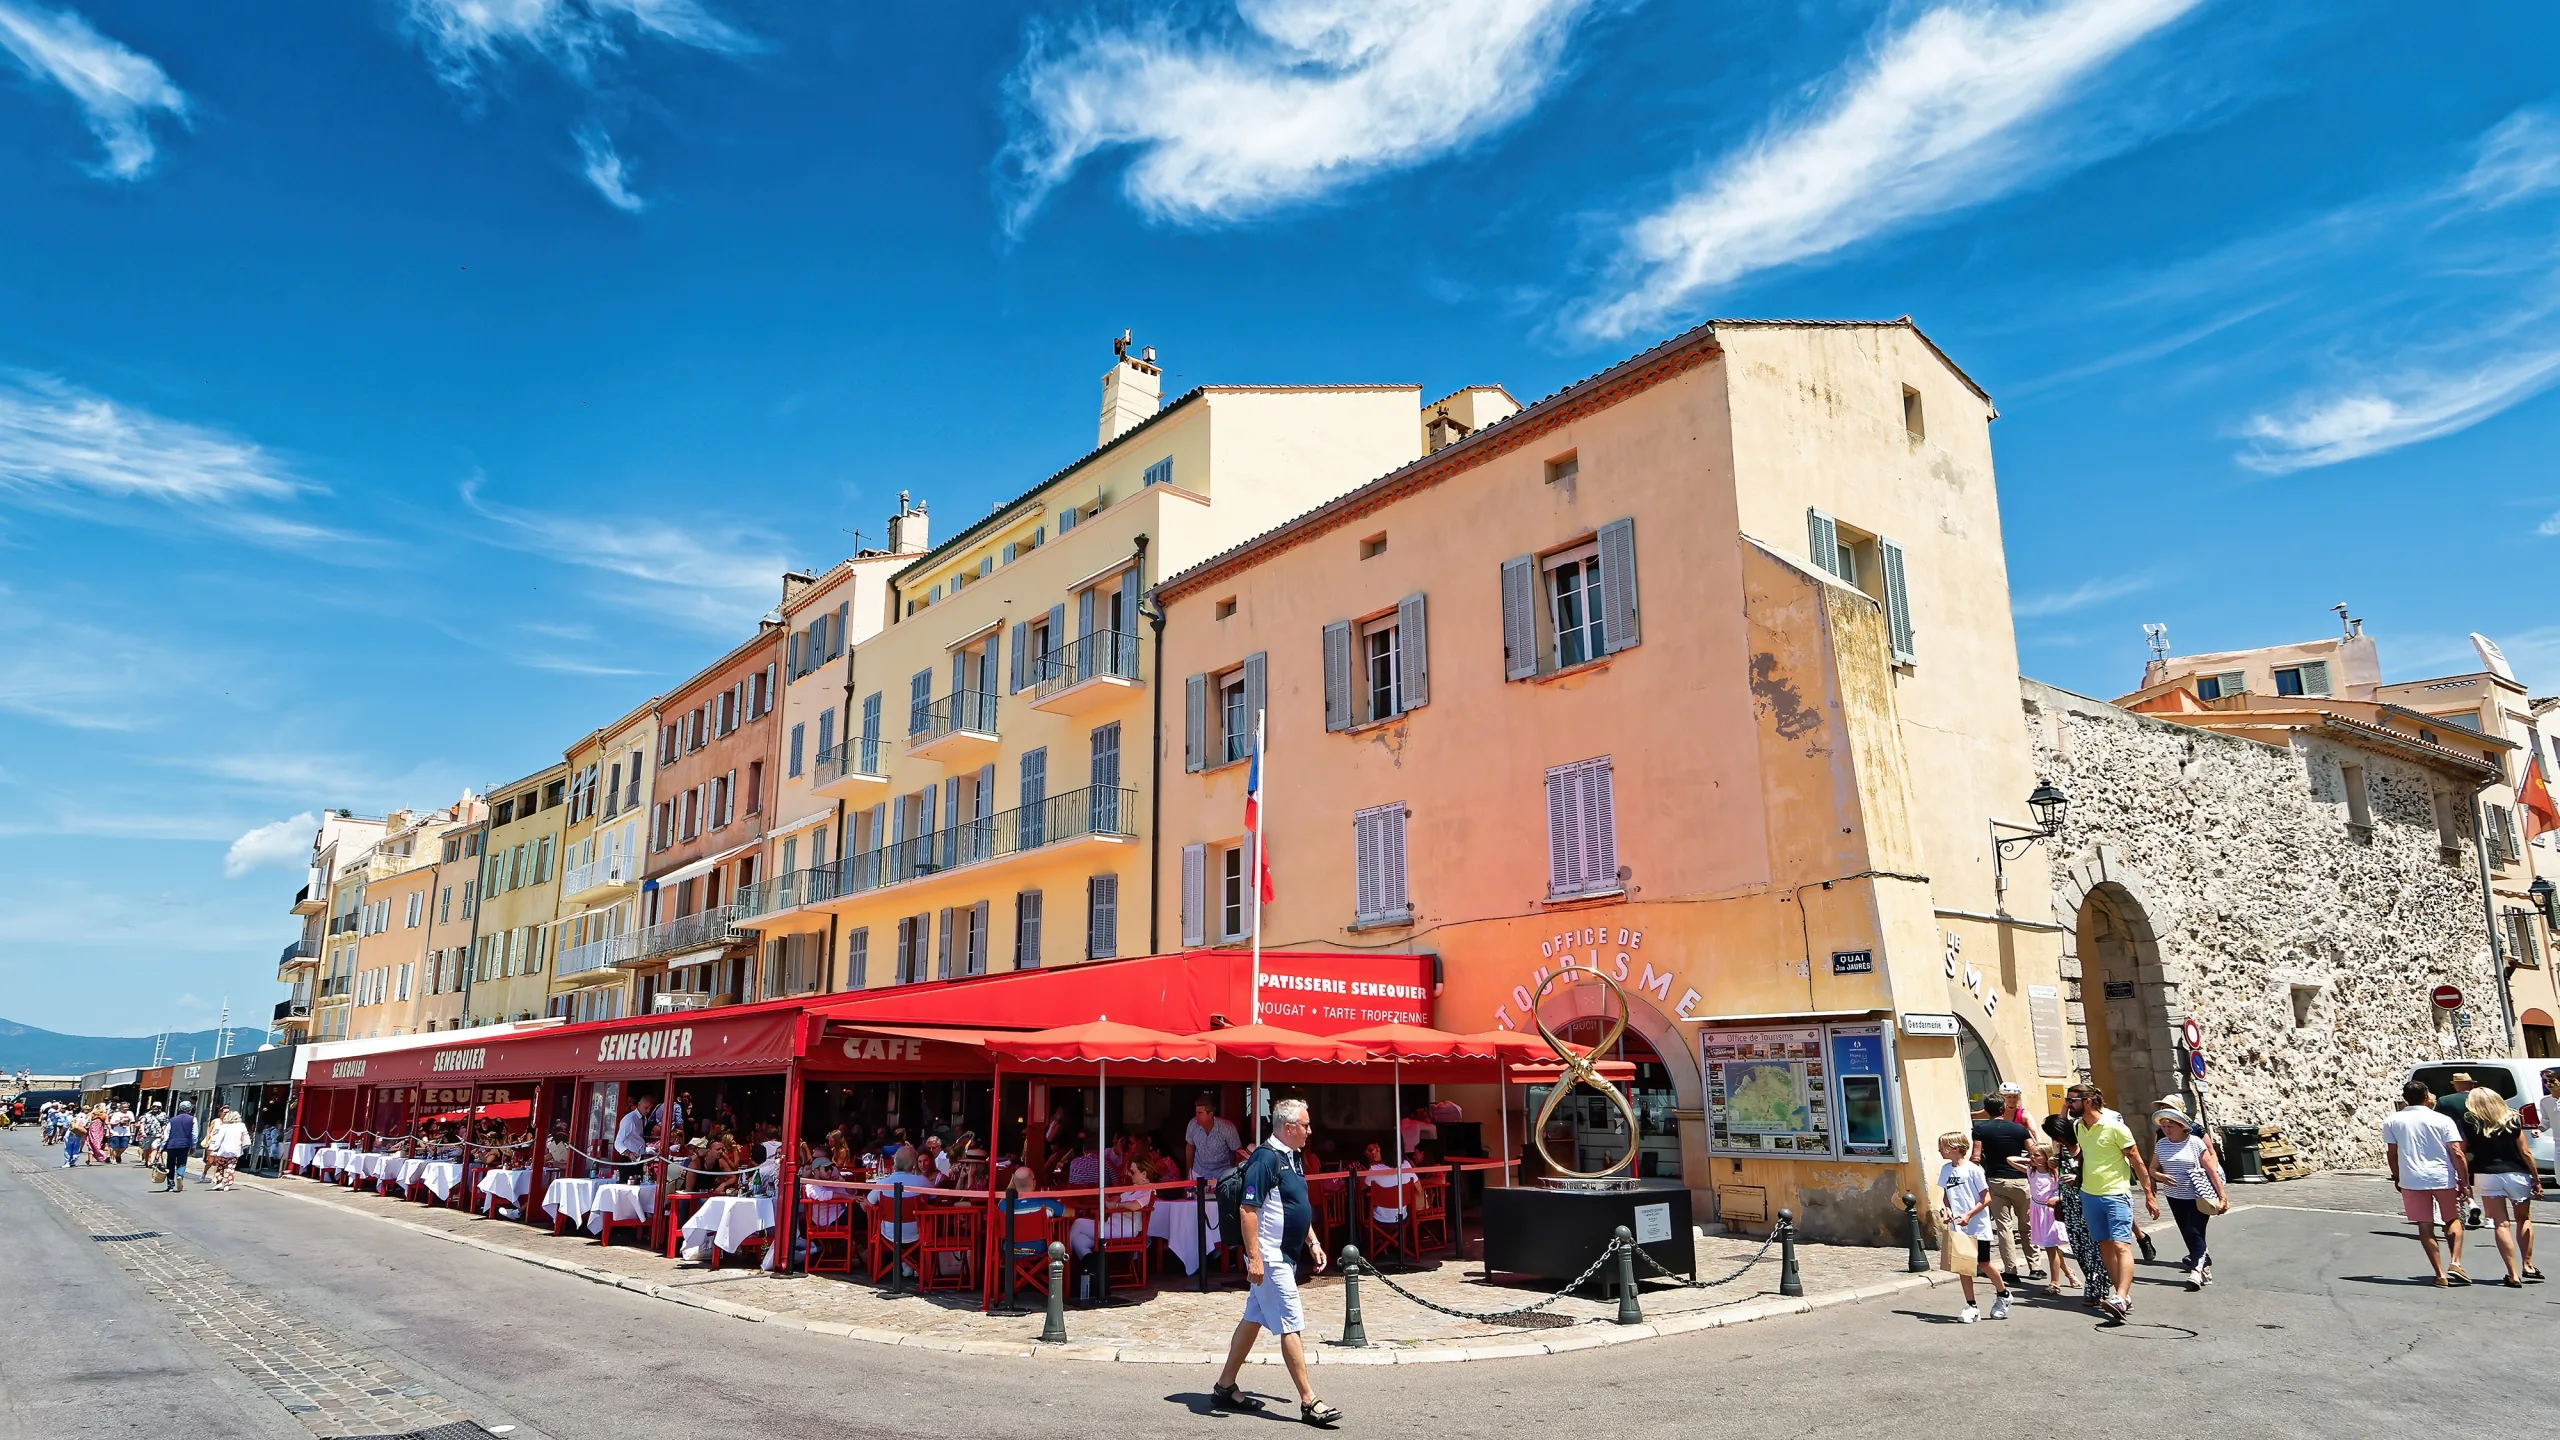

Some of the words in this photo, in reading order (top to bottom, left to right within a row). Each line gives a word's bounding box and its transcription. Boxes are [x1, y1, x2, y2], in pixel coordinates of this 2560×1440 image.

[1541, 927, 1607, 958] OFFICE
[1617, 928, 1643, 949] DE
[1840, 955, 1864, 964] QUAI
[1258, 973, 1347, 994] PATISSERIE
[1351, 982, 1427, 1000] SENEQUIER
[1495, 949, 1703, 1030] TOURISME
[1945, 948, 1999, 1018] SME
[1257, 1002, 1305, 1017] NOUGAT
[1323, 1006, 1356, 1020] TARTE
[597, 1027, 693, 1062] SENEQUIER
[842, 1038, 922, 1061] CAFE
[1727, 1034, 1748, 1042] Office
[1750, 1034, 1758, 1042] de
[1760, 1033, 1794, 1041] Tourisme
[331, 1060, 367, 1079] SENEQUIER
[432, 1048, 486, 1072] SENEQUIER
